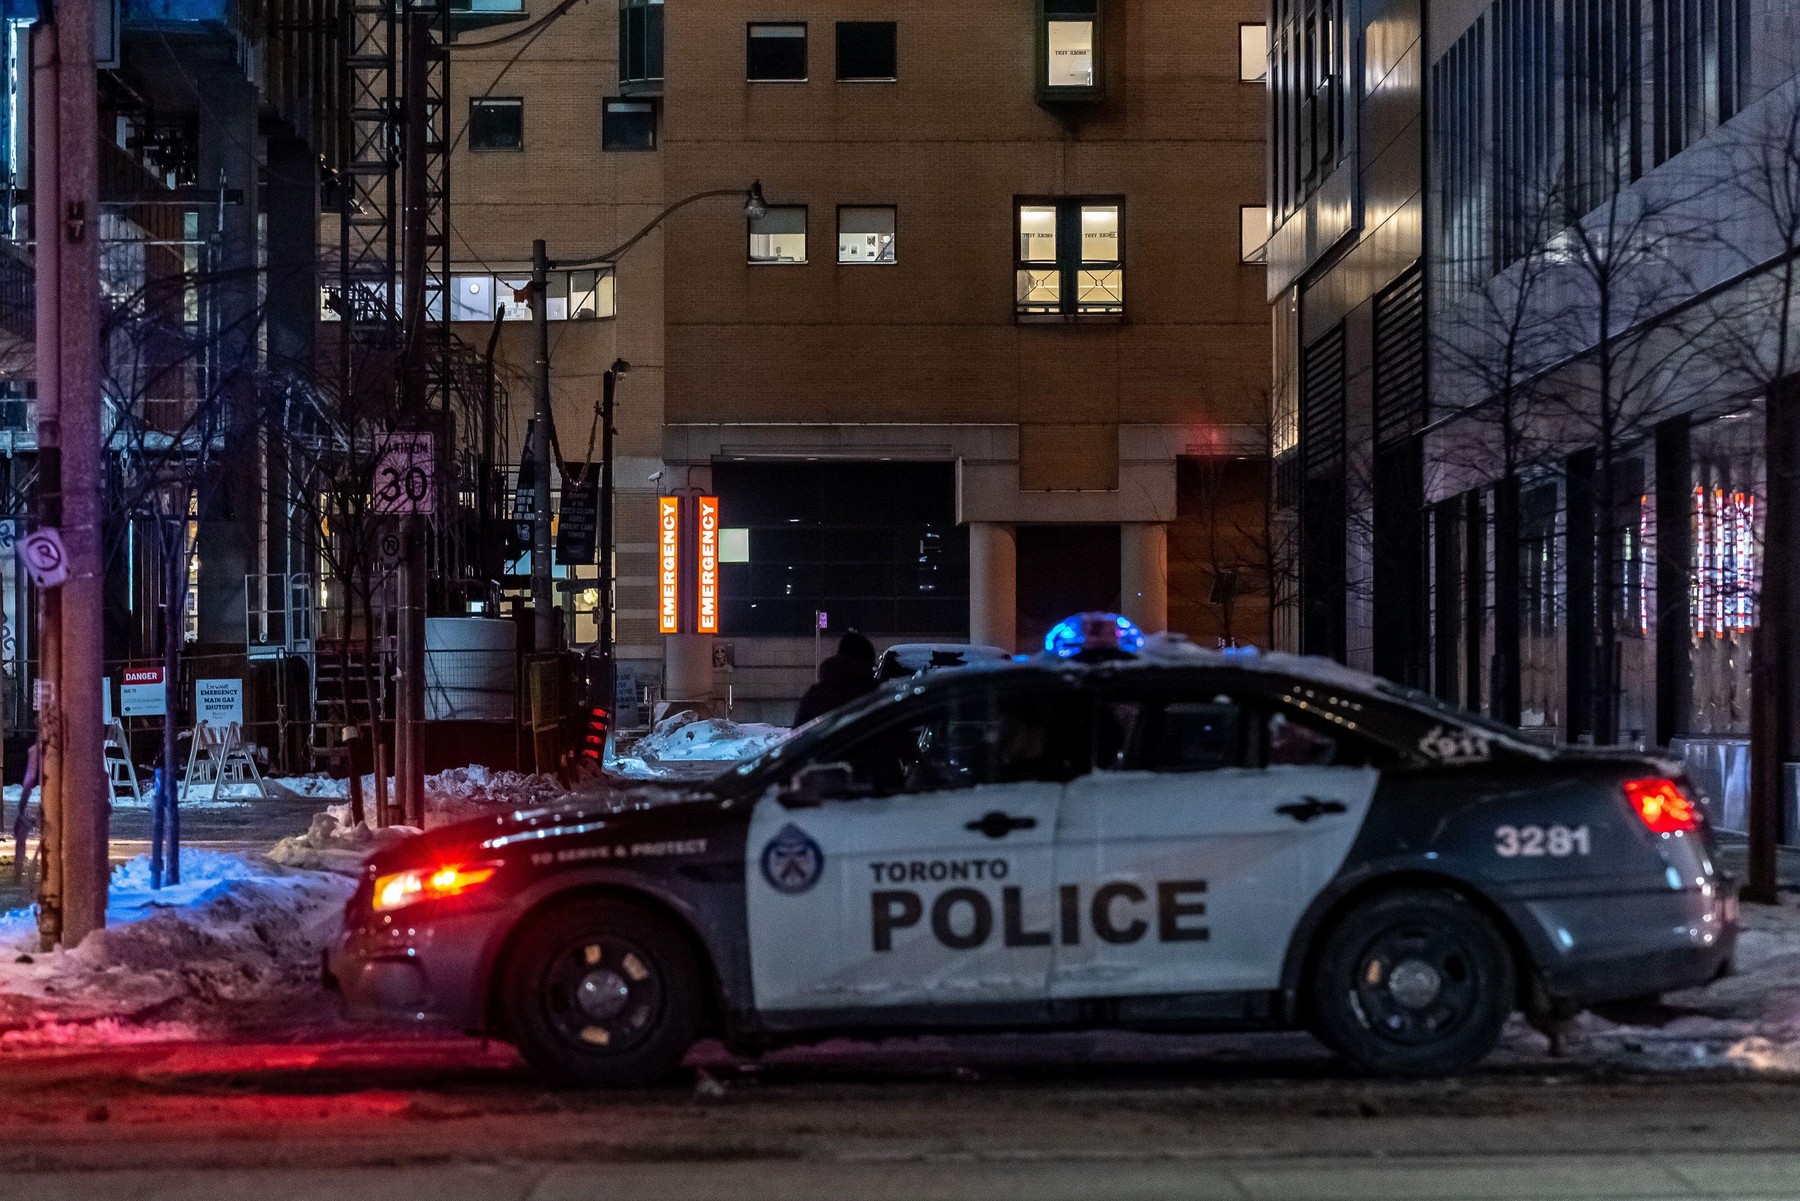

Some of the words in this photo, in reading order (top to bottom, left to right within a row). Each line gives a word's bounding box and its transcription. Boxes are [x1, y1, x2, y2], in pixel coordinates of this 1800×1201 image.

[381, 466, 427, 502] 30
[664, 503, 675, 628] EMERGENCY
[702, 503, 714, 628] EMERGENCY
[125, 672, 158, 681] DANGER
[530, 851, 554, 866] TO
[556, 845, 610, 862] SERVE
[613, 844, 628, 858] &
[630, 838, 708, 857] PROTECT
[1494, 824, 1591, 858] 3281
[870, 858, 1009, 883] TORONTO
[871, 879, 1210, 952] POLICE
